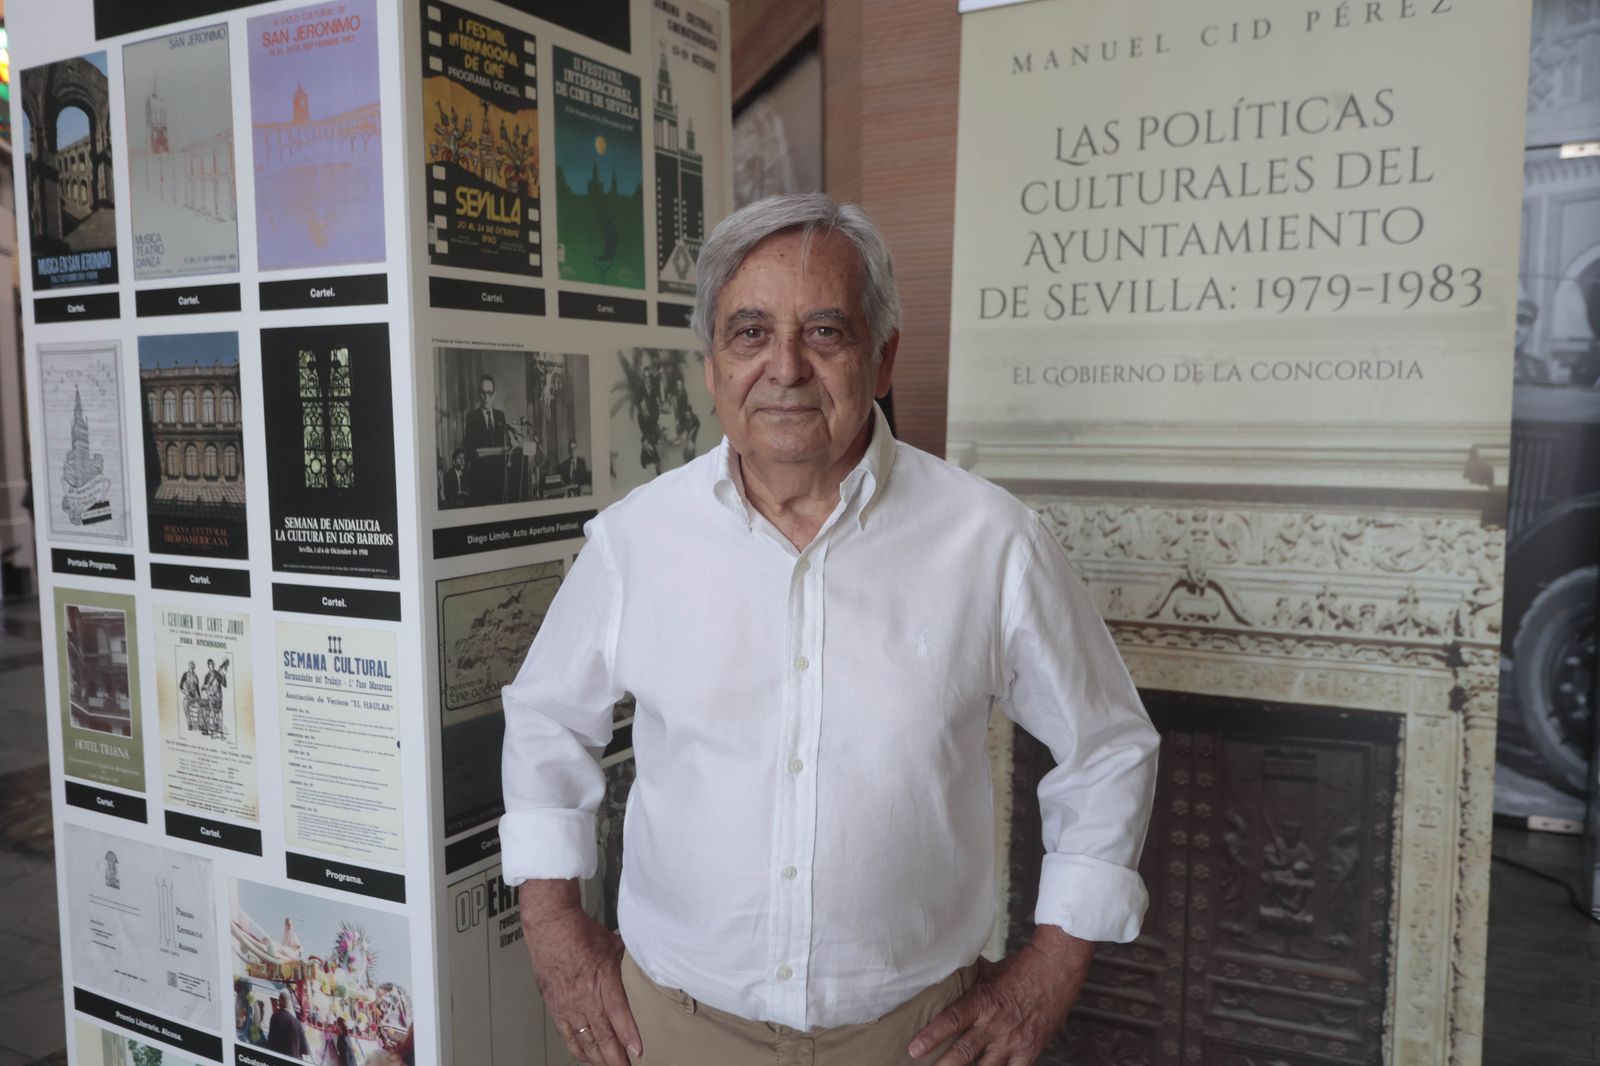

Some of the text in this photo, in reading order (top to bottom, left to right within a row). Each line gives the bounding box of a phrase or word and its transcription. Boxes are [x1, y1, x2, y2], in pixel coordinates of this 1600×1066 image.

[169, 27, 226, 51] SAN JERONIMO
[262, 15, 361, 48] SAN JERONIMO
[459, 16, 507, 47] I FESTIVAL
[1011, 0, 1453, 75] MANUEL CID PÉREZ
[465, 54, 505, 79] DE CINE
[582, 59, 623, 86] FESTIVAL
[448, 66, 520, 97] PROGRAMA OFICIAL
[563, 68, 632, 103] INTERNACIONAL
[556, 81, 568, 97] DE
[569, 86, 591, 104] CINE
[592, 93, 604, 109] DE
[605, 97, 640, 120] SEVILLA
[1056, 88, 1394, 167] LAS POLÍTICAS
[1020, 145, 1435, 215] CULTURALES DEL
[455, 186, 521, 225] SEVILLA
[136, 245, 165, 257] TEATRO
[1023, 206, 1425, 275] AYUNTAMIENTO
[81, 250, 112, 270] JERONIMO
[136, 256, 161, 268] DANZA
[309, 287, 336, 298] Cartel.
[978, 285, 1031, 320] DE
[1044, 276, 1237, 321] SEVILLA:
[1013, 360, 1424, 388] EL GOBIERNO DE LA CONCORDIA
[275, 529, 394, 546] LA CULTURA EN LOS BARRIOS
[284, 517, 381, 533] SEMANA DE ANDALUCIA
[467, 535, 487, 544] Diego
[489, 531, 511, 542] Limón.
[513, 528, 528, 538] Acto
[529, 524, 555, 537] Apertura
[322, 596, 347, 608] Cartel.
[328, 635, 343, 655] III
[283, 650, 392, 679] SEMANA CULTURAL
[317, 695, 325, 704] de
[326, 696, 349, 708] Vecinos
[75, 738, 130, 760] HOTEL TRIANA
[480, 837, 500, 850] Carte
[325, 868, 365, 886] Programa.
